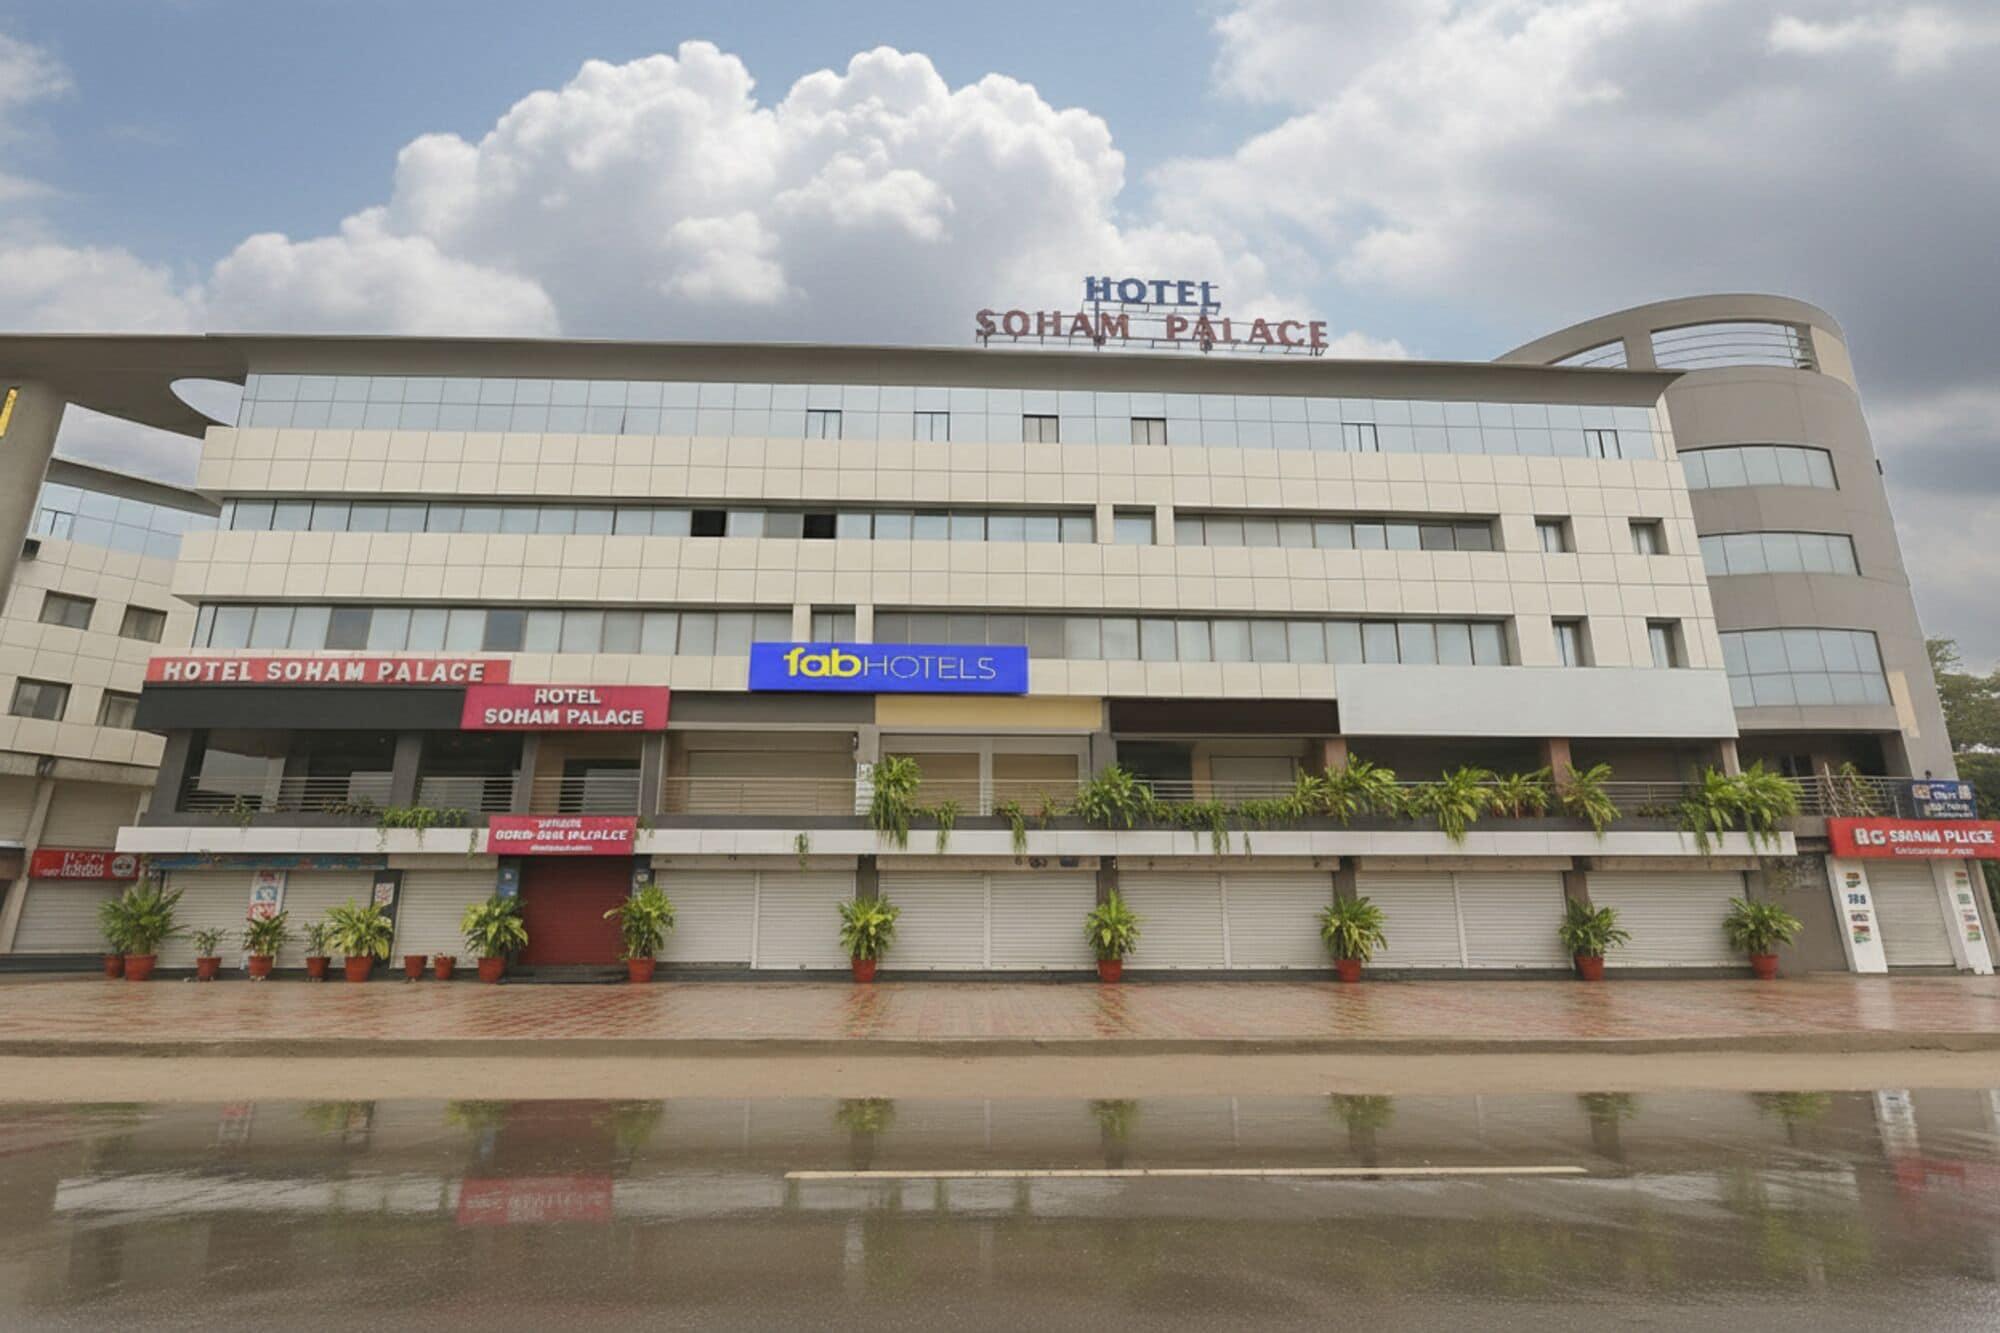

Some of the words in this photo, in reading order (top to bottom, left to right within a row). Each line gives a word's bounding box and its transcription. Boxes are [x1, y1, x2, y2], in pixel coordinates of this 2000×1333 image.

[1085, 276, 1221, 306] HOTEL
[976, 308, 1130, 342] SOHAM
[1166, 314, 1329, 349] PALACE
[163, 661, 253, 682] HOTEL
[267, 660, 365, 682] SOHAM
[377, 663, 486, 682] PALACE
[484, 708, 560, 724] SOHAM
[567, 709, 645, 725] PALACE
